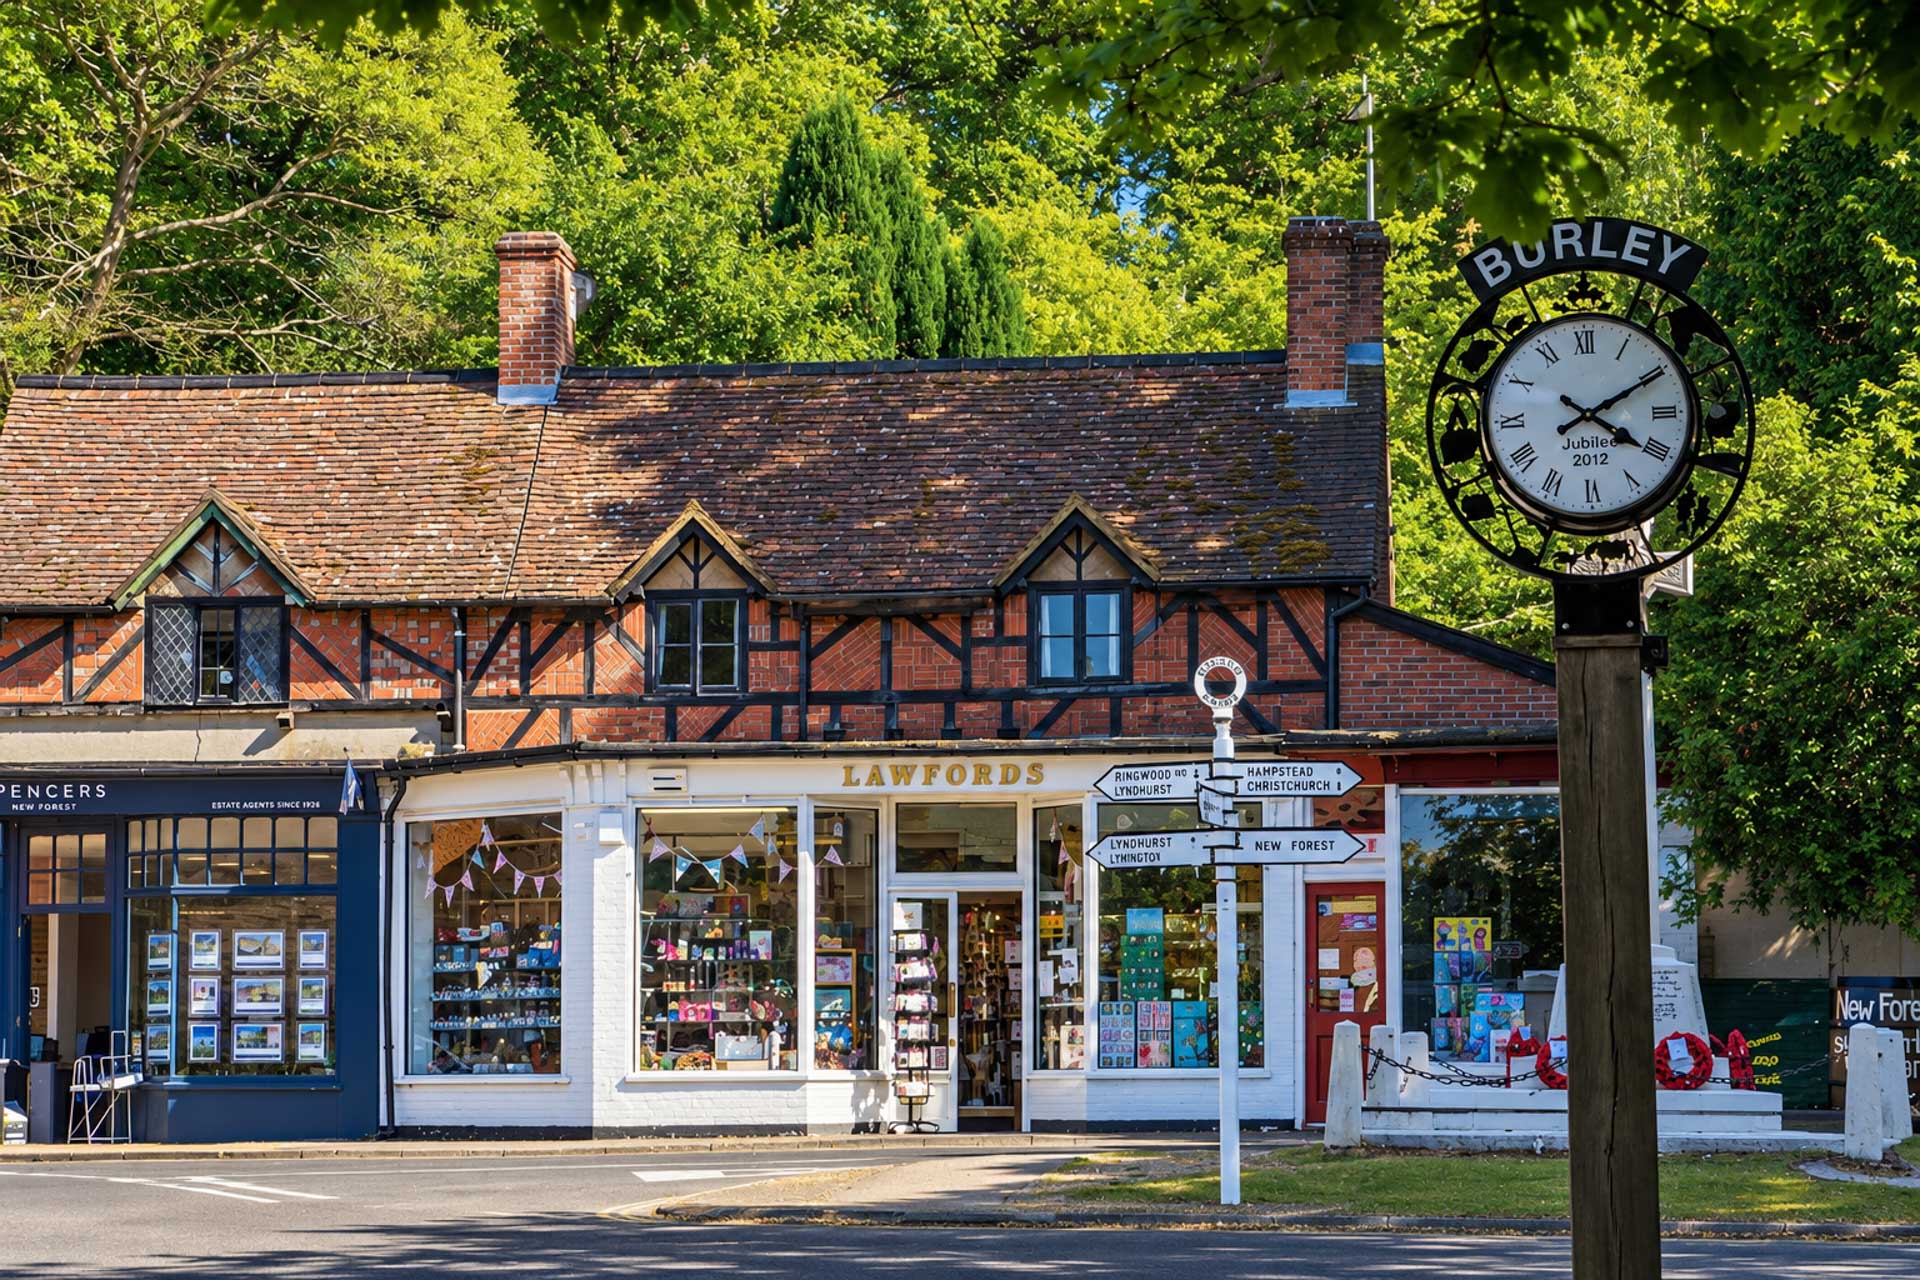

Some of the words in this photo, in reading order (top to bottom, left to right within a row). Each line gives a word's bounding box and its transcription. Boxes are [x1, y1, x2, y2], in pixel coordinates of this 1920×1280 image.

[1473, 221, 1692, 288] BURLEY
[1574, 330, 1596, 355] XII
[1535, 341, 1560, 369] XI
[1508, 373, 1535, 392] X
[1651, 405, 1677, 421] III
[1562, 435, 1617, 450] Jubilee
[1572, 452, 1609, 467] 2012
[841, 762, 1045, 787] LAWFORDS
[1114, 769, 1172, 782] RINGWOOD
[1247, 766, 1313, 777] HAMPSTEAD
[1114, 784, 1173, 797] LYNDHURST
[1247, 780, 1330, 792] CHRISTCHURCH
[12, 803, 35, 811] NEW
[38, 803, 77, 811] FOREST
[211, 801, 241, 809] ESTATE
[243, 801, 275, 809] AGENTS
[277, 801, 300, 809] SINCE
[1110, 837, 1173, 850] LYNDHURST
[1255, 840, 1282, 851] NEW
[1291, 840, 1335, 851] FOREST
[1836, 989, 1876, 1021] New
[1879, 992, 1920, 1022] Fore
